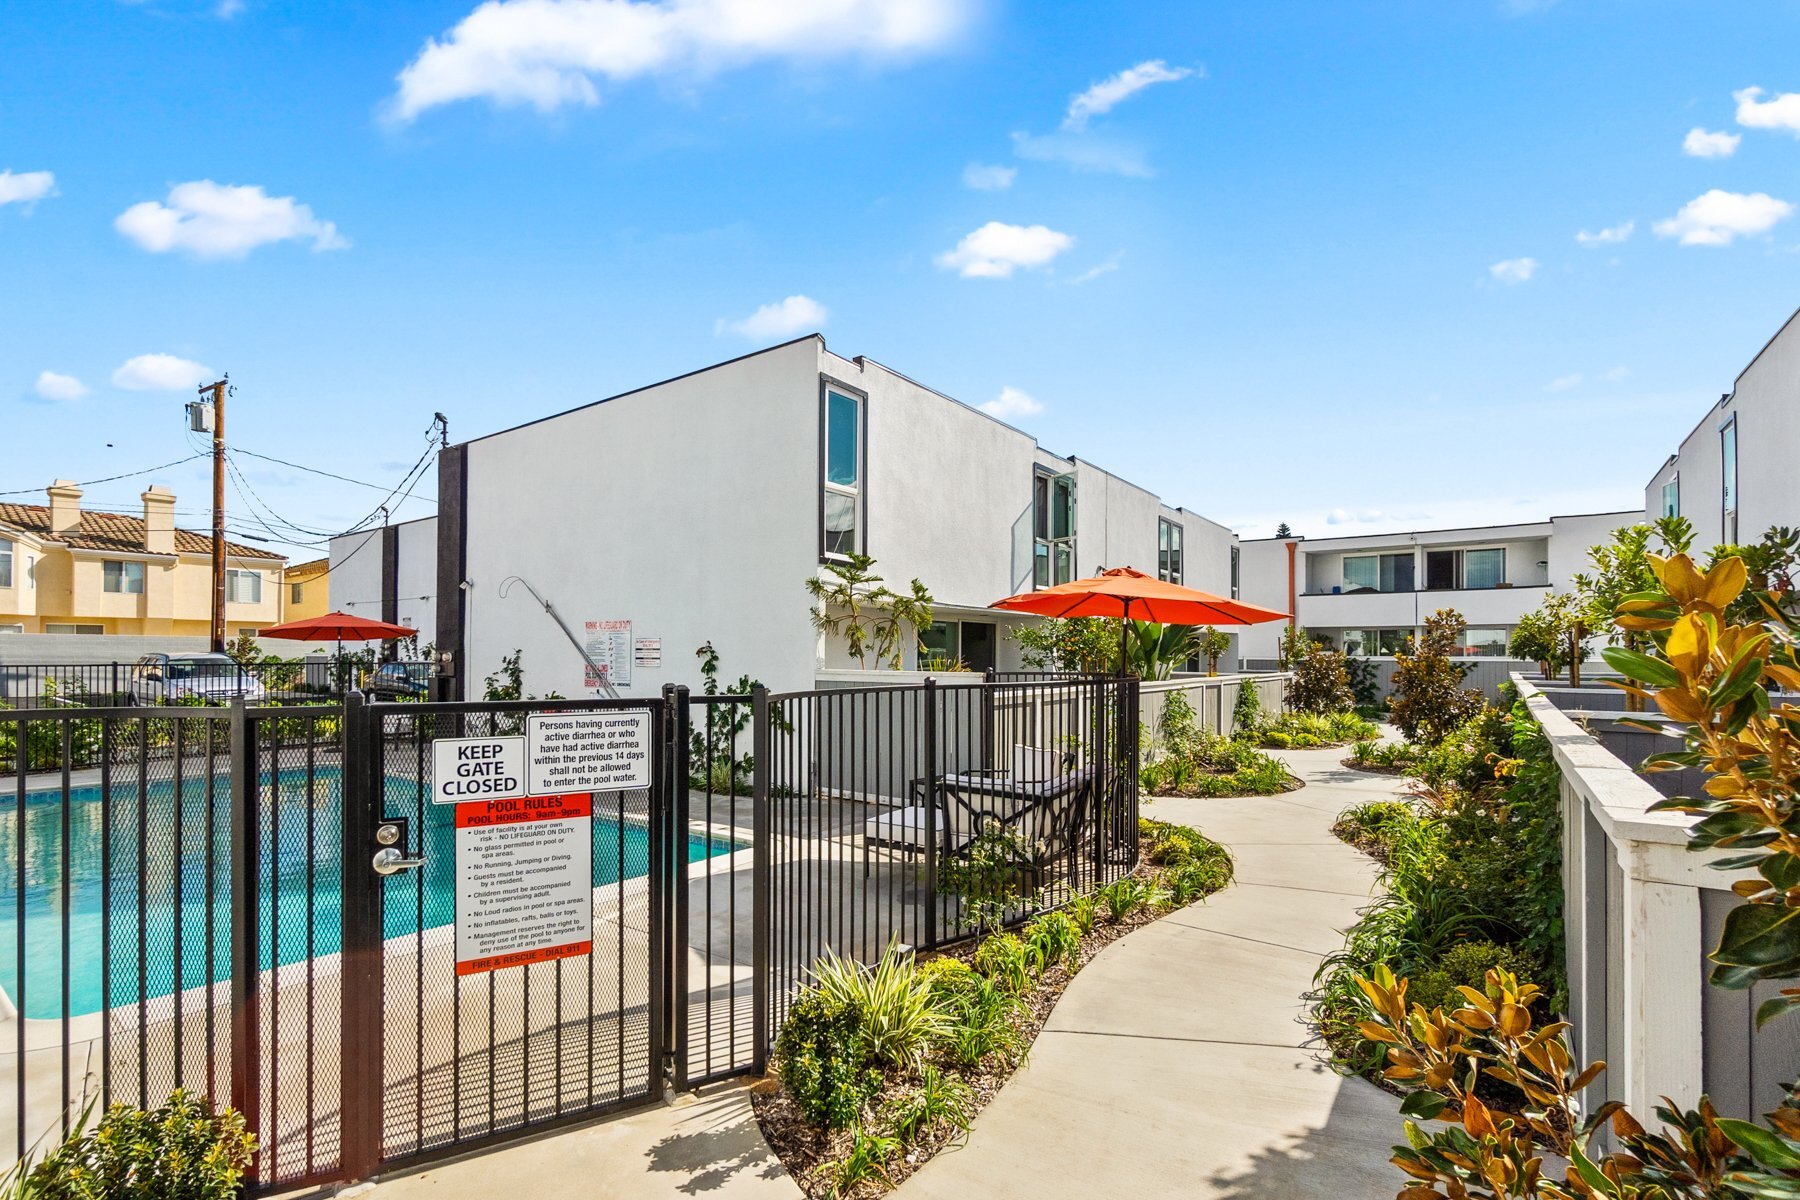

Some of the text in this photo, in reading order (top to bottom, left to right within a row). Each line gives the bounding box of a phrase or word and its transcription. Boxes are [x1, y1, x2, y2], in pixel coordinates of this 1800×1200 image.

[540, 719, 640, 730] Persons having currently
[545, 733, 569, 741] active
[572, 731, 605, 740] diarrhea
[563, 743, 578, 752] had
[581, 742, 604, 750] active
[607, 740, 639, 750] diarrhea
[458, 745, 503, 760] KEEP
[534, 756, 560, 764] within
[579, 753, 612, 764] previous
[627, 751, 644, 760] days
[457, 761, 504, 777] GATE
[550, 766, 569, 775] shall
[600, 762, 631, 772] allowed
[443, 778, 517, 795] CLOSED
[554, 778, 576, 786] enter
[594, 775, 610, 785] pool
[487, 798, 563, 813] POOL RULES
[468, 816, 493, 824] POOL
[496, 812, 530, 821] HOURS:
[511, 830, 545, 839] LIFEGUARD
[504, 840, 534, 849] permitted
[515, 857, 542, 866] Jumping
[525, 864, 567, 874] accompanied
[497, 877, 524, 885] resident.
[474, 890, 500, 898] Children
[530, 881, 571, 891] accompanied
[495, 893, 532, 902] supervising
[484, 918, 520, 927] inflatables,
[474, 928, 516, 939] Management
[518, 924, 545, 933] reserves
[472, 960, 492, 969] FIRE
[503, 952, 537, 964] RESCUE
[546, 948, 564, 957] DIAL
